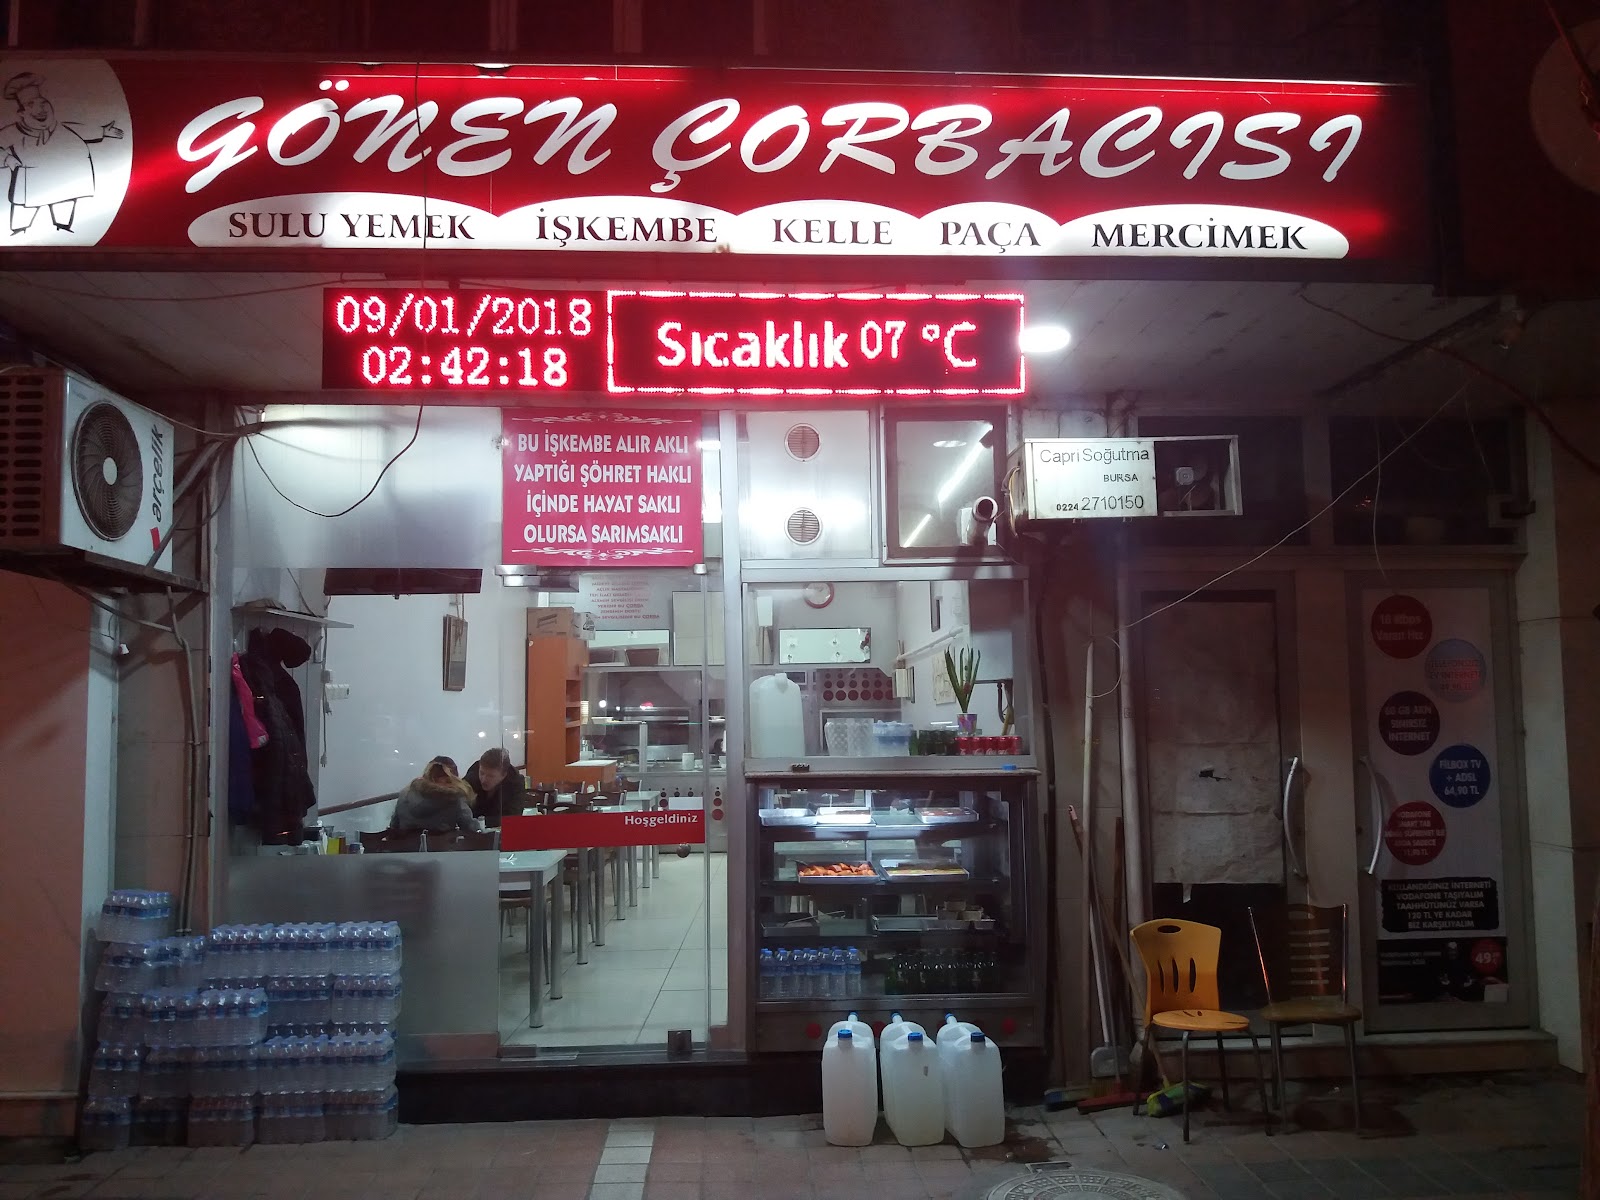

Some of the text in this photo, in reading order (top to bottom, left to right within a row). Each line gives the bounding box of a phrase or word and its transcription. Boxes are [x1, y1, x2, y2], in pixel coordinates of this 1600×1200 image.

[176, 78, 1363, 193] GÖNEN ÇORBACISI
[228, 211, 475, 241] SULU YEMEK
[537, 207, 719, 248] İŞKEMBE
[773, 218, 893, 246] KELLE
[938, 221, 1042, 254] PAÇA
[1092, 216, 1309, 251] MERCİMEK
[335, 293, 593, 337] 09/01/2018
[657, 320, 849, 368] Sıcaklık
[860, 320, 907, 360] 07
[361, 346, 568, 387] 02:42:18
[518, 429, 689, 457] BU İŞKEMBE ALIR AKLI
[1040, 447, 1150, 465] Capri Soğutma
[151, 424, 164, 523] arçelik
[514, 460, 692, 488] YAPTIĞI ŞÖHRET HAKLI
[1103, 473, 1139, 483] BURSA
[526, 489, 681, 518] İÇİNDE HAYAT SAKLI
[1056, 495, 1144, 512] 0224 2710150
[523, 524, 683, 544] OLURSA SARIMSAKLI
[1455, 772, 1478, 782] ADSL
[1470, 759, 1482, 769] TV
[1469, 785, 1480, 795] TL
[624, 812, 698, 827] Hoşgeldiniz
[1423, 911, 1434, 920] TL
[1445, 910, 1473, 919] KADAR
